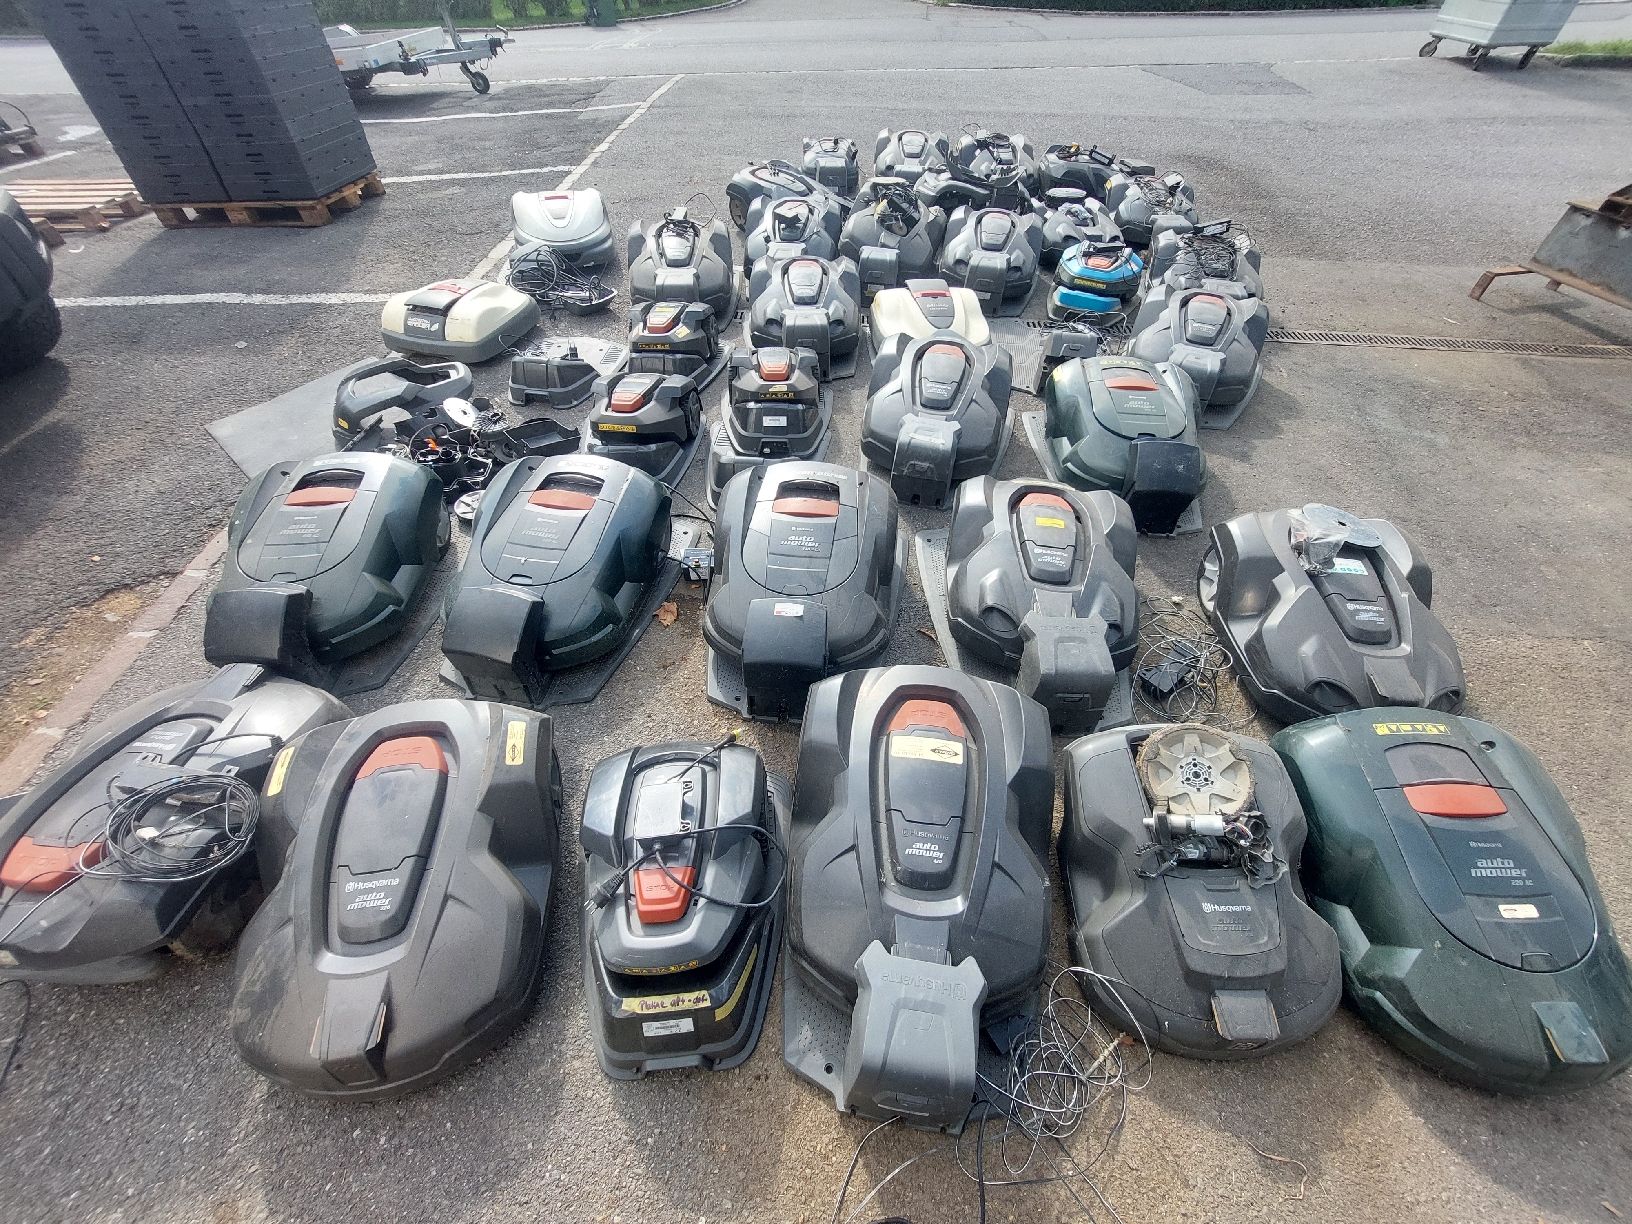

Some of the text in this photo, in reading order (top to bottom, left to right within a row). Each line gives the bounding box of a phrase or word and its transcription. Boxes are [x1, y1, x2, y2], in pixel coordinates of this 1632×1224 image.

[912, 842, 939, 850] auto
[904, 848, 945, 859] mower
[1477, 858, 1515, 868] auto
[1470, 868, 1528, 877] mower
[354, 878, 399, 890] Husqvarna
[355, 892, 385, 902] auto
[346, 898, 392, 911] mower
[1210, 903, 1252, 912] Husqvarna
